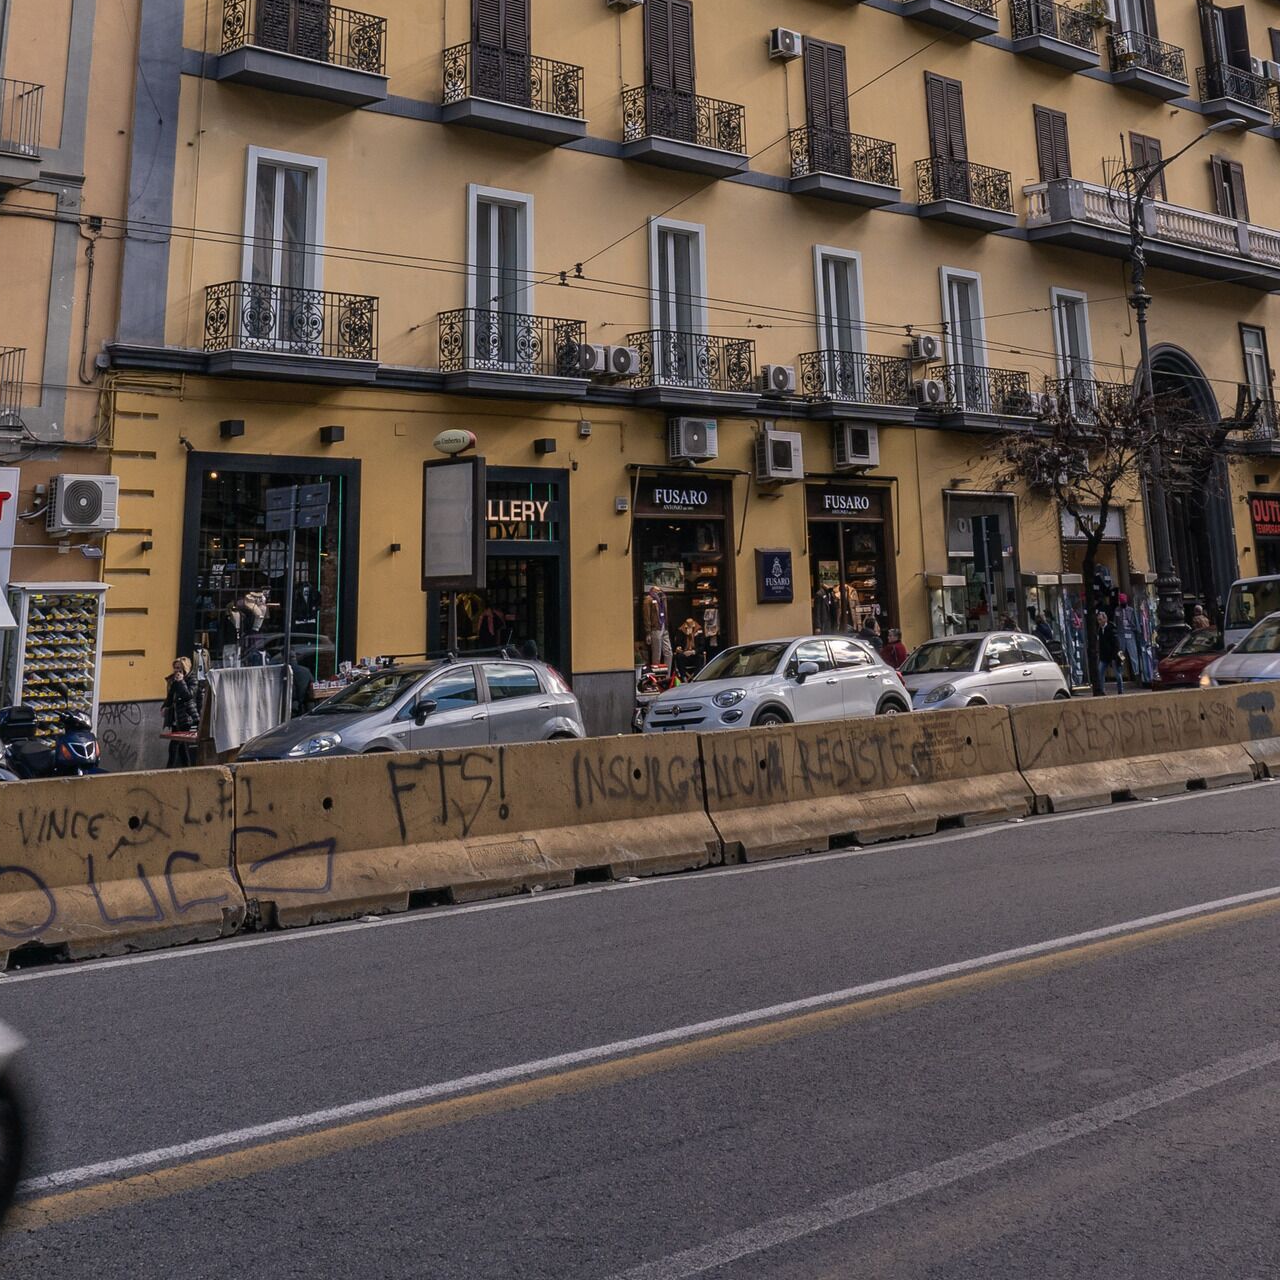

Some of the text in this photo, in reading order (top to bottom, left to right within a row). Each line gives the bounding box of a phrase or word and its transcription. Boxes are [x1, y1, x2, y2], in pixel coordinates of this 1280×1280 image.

[655, 488, 708, 505] FUSARO
[824, 494, 870, 510] FUSARO
[485, 499, 549, 522] LLERY
[765, 577, 790, 587] FUSARO
